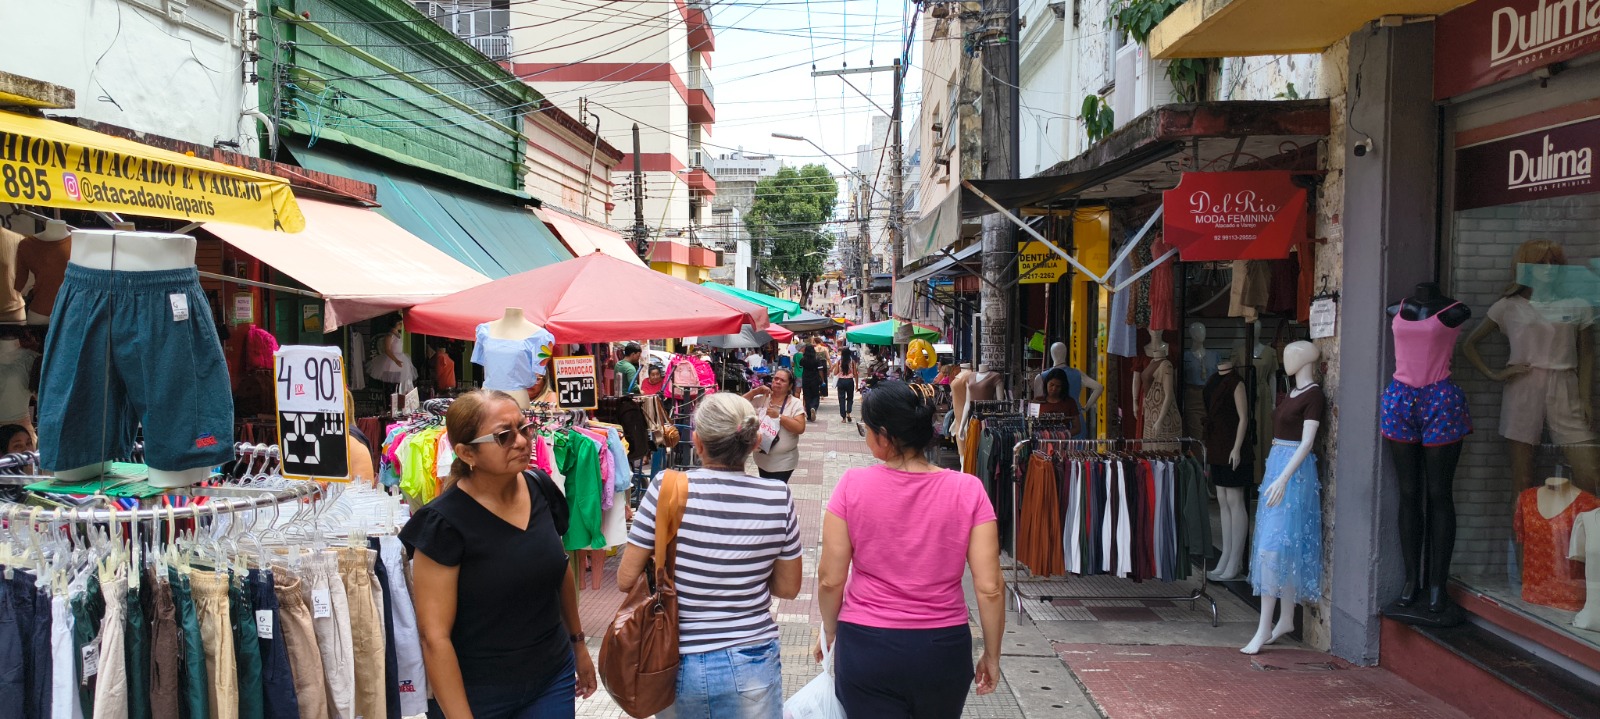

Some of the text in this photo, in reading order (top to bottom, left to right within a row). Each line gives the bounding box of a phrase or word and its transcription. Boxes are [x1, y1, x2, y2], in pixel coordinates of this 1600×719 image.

[1517, 53, 1544, 67] MODA
[75, 146, 176, 187] ATACADO
[182, 167, 193, 190] E
[198, 170, 262, 202] VAREJO
[1508, 134, 1592, 186] Dulima
[2, 163, 51, 202] 895
[80, 176, 215, 217] @atacadaoviaparis
[1189, 189, 1280, 214] Del Rio
[1195, 214, 1275, 224] MODA FEMININA
[278, 357, 292, 400] 4
